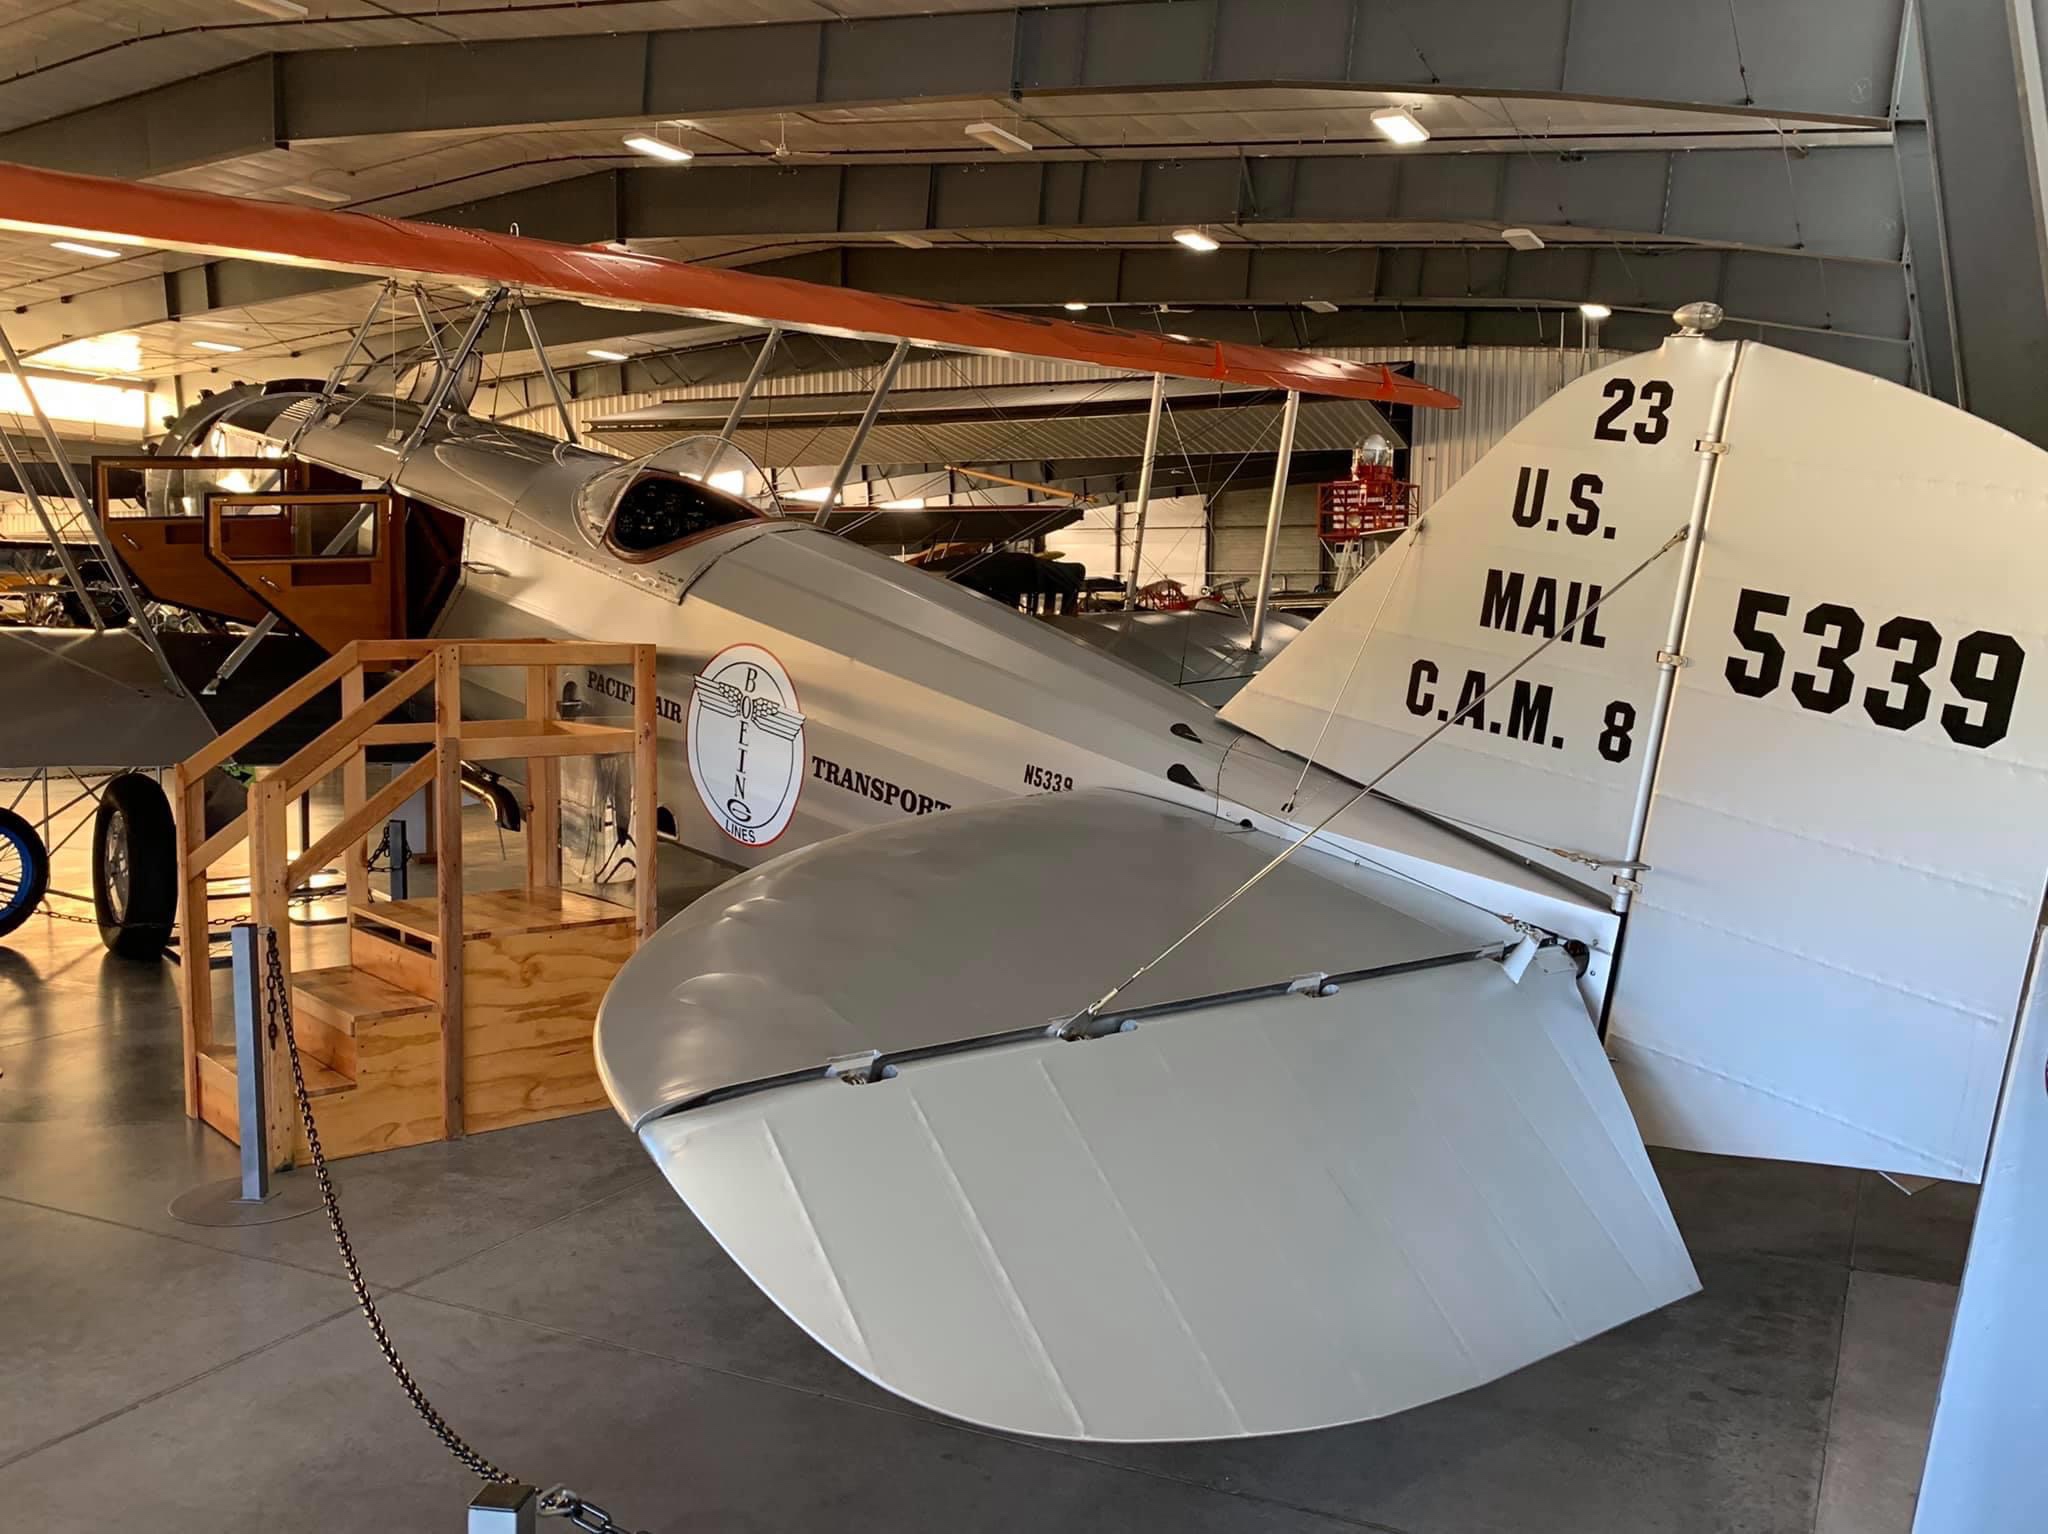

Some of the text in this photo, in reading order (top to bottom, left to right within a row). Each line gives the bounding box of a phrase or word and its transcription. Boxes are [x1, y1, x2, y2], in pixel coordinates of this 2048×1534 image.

[1594, 377, 1674, 445] 23
[1511, 466, 1617, 539] U.S.
[1478, 567, 1606, 649] MAIL
[1724, 587, 2026, 750] 5339
[727, 667, 758, 823] BOEING
[1405, 658, 1637, 763] C.A.M. 8
[725, 819, 756, 843] LINES
